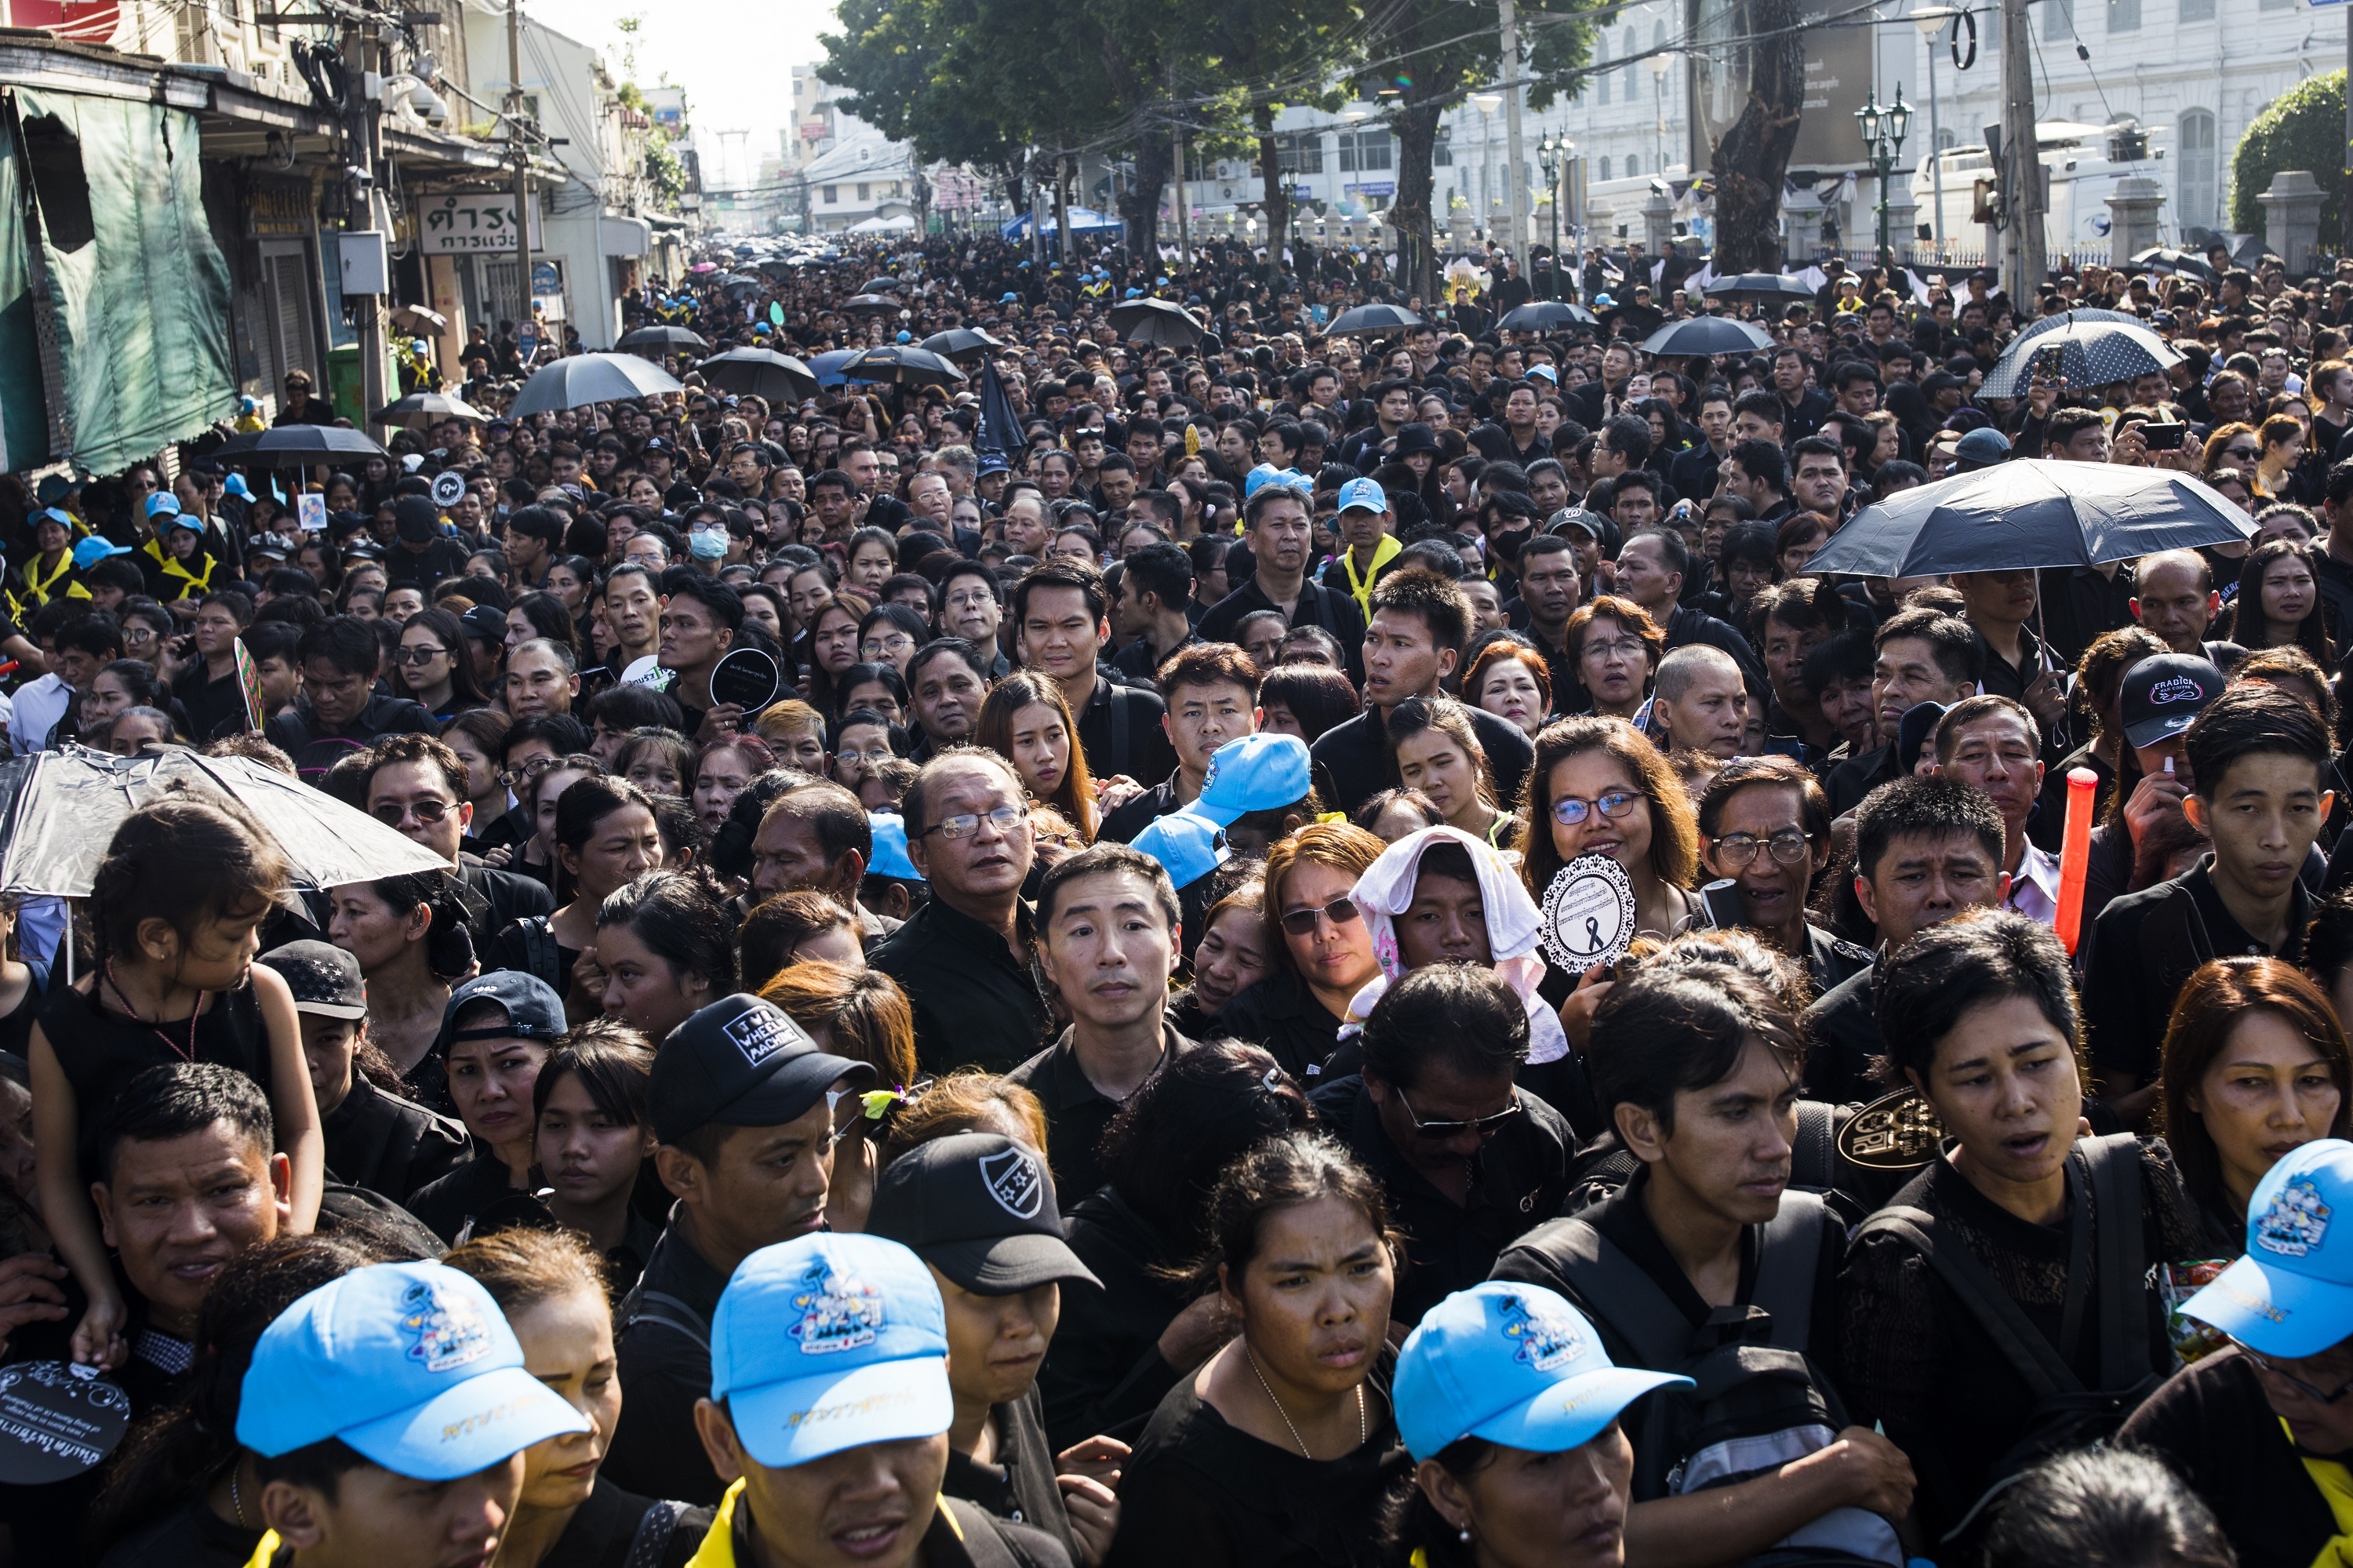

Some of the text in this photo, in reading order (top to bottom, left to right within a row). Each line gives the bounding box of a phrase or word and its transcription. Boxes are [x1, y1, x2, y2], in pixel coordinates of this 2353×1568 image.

[2155, 675, 2194, 689] ERABICA
[1, 1394, 34, 1410] Thailand
[25, 1413, 38, 1421] the
[52, 1413, 74, 1424] Rama
[47, 1421, 66, 1432] born
[67, 1427, 82, 1435] was
[0, 1420, 100, 1465] ฉันเกิดในรัชกา
